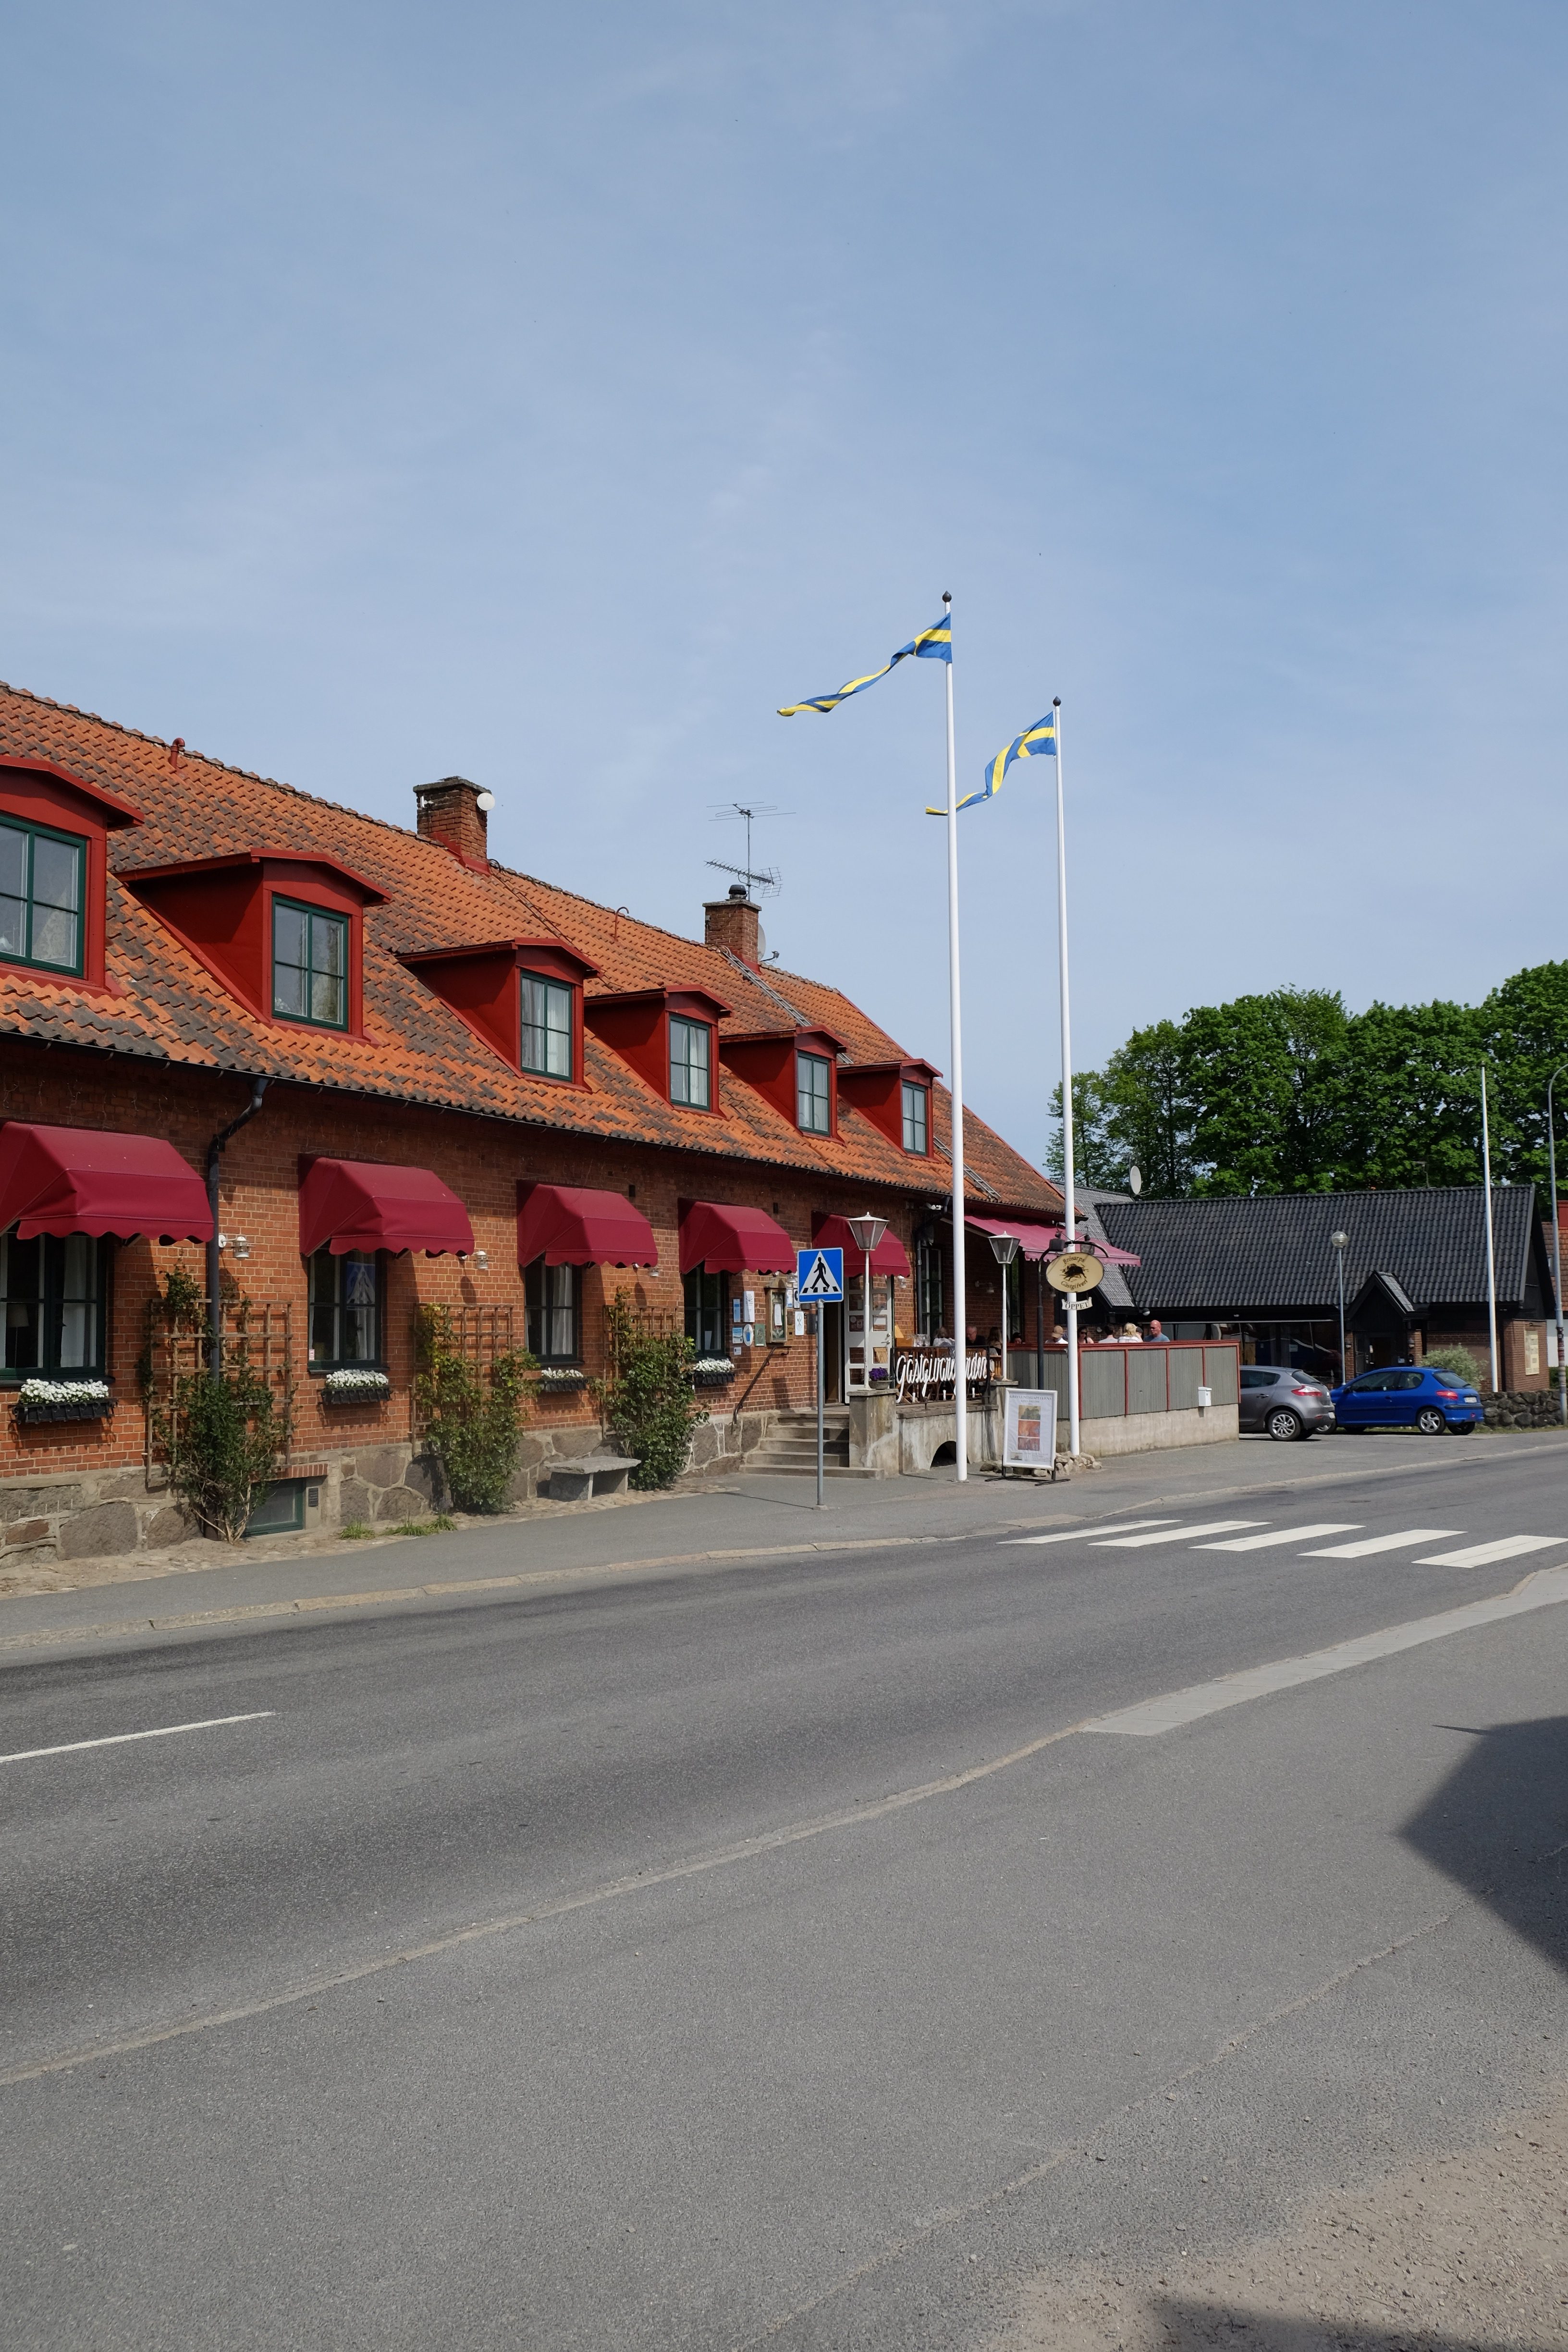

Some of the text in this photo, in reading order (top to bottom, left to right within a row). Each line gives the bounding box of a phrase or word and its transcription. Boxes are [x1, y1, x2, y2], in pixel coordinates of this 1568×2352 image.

[1063, 1256, 1085, 1264] Brösarps
[1065, 1300, 1089, 1309] ÖPPET
[895, 1352, 987, 1404] Gästgivarerden
